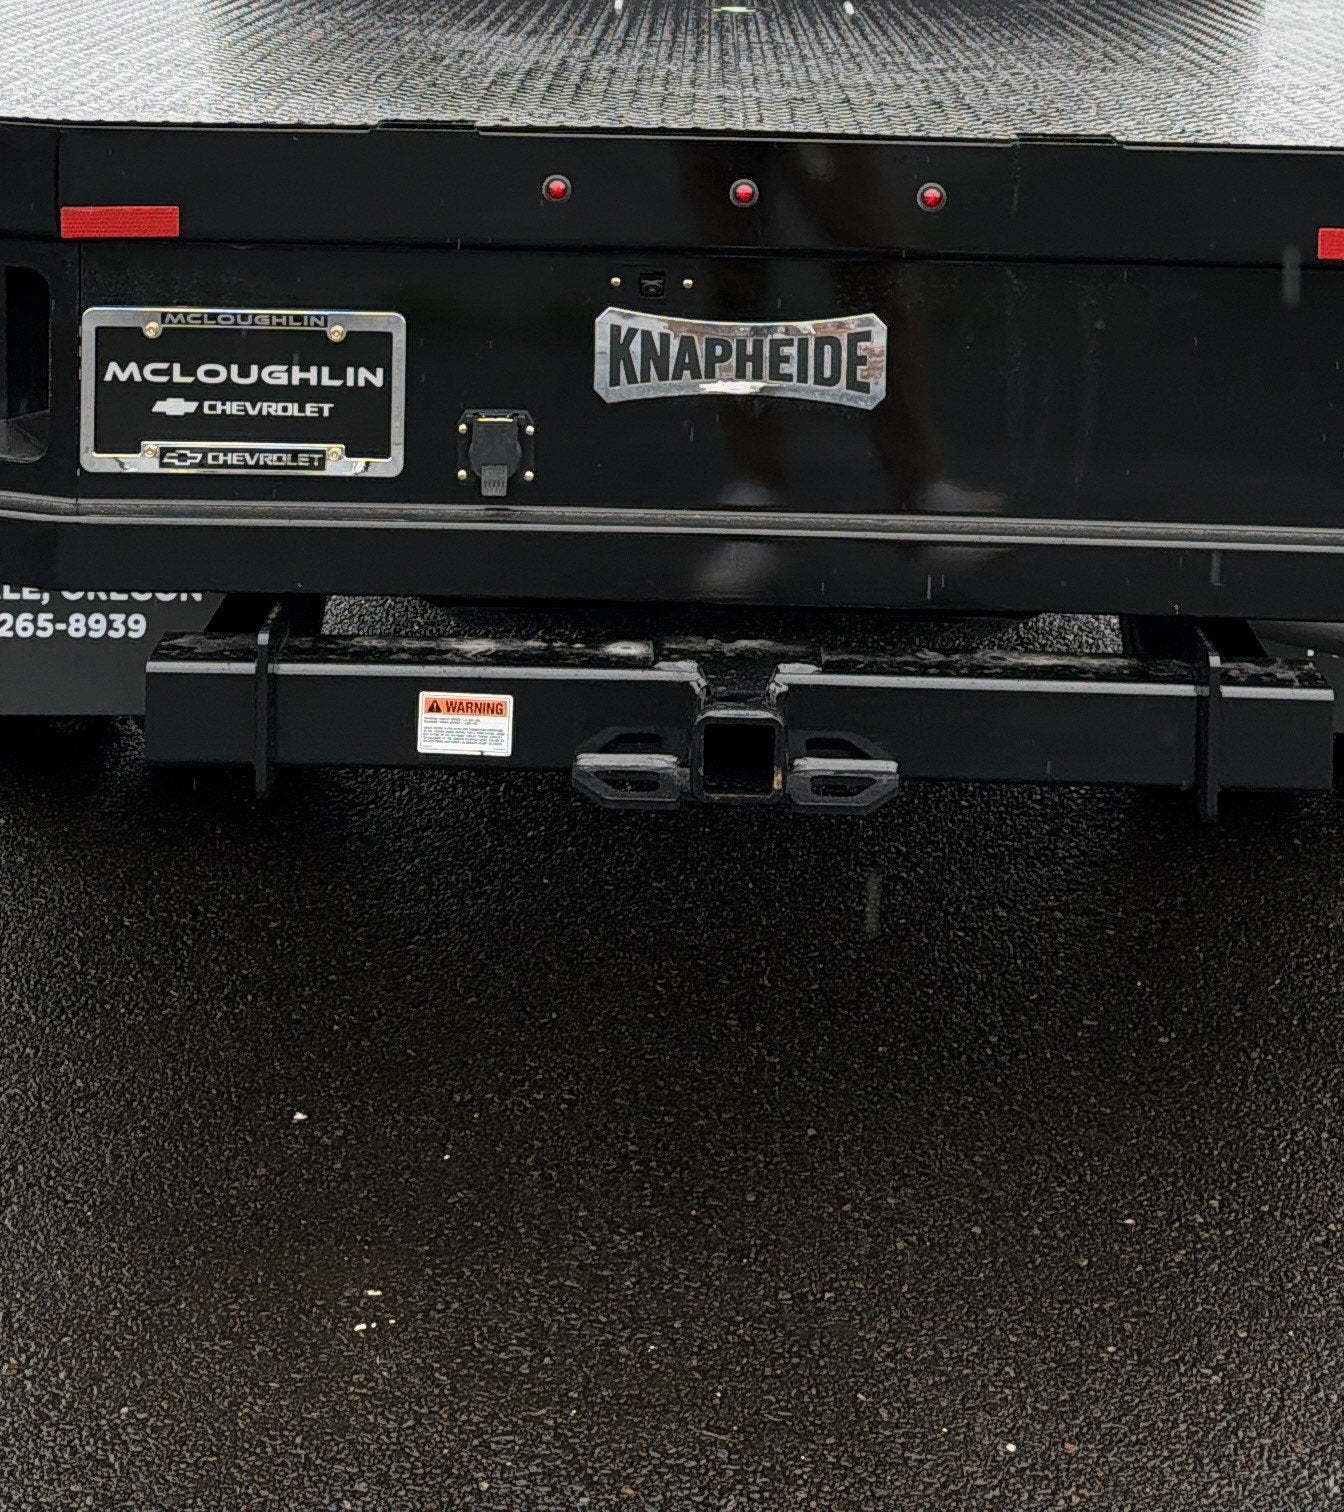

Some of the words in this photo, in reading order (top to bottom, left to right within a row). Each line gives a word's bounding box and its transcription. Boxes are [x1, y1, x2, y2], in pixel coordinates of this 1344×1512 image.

[164, 313, 326, 327] MCLOUGHLIN
[609, 324, 872, 394] KNAPHEIDE
[104, 361, 384, 388] MCLOUGHLIN
[203, 400, 334, 417] CHEVROLET
[206, 452, 324, 467] CHEVROLET
[445, 700, 504, 715] WARNING
